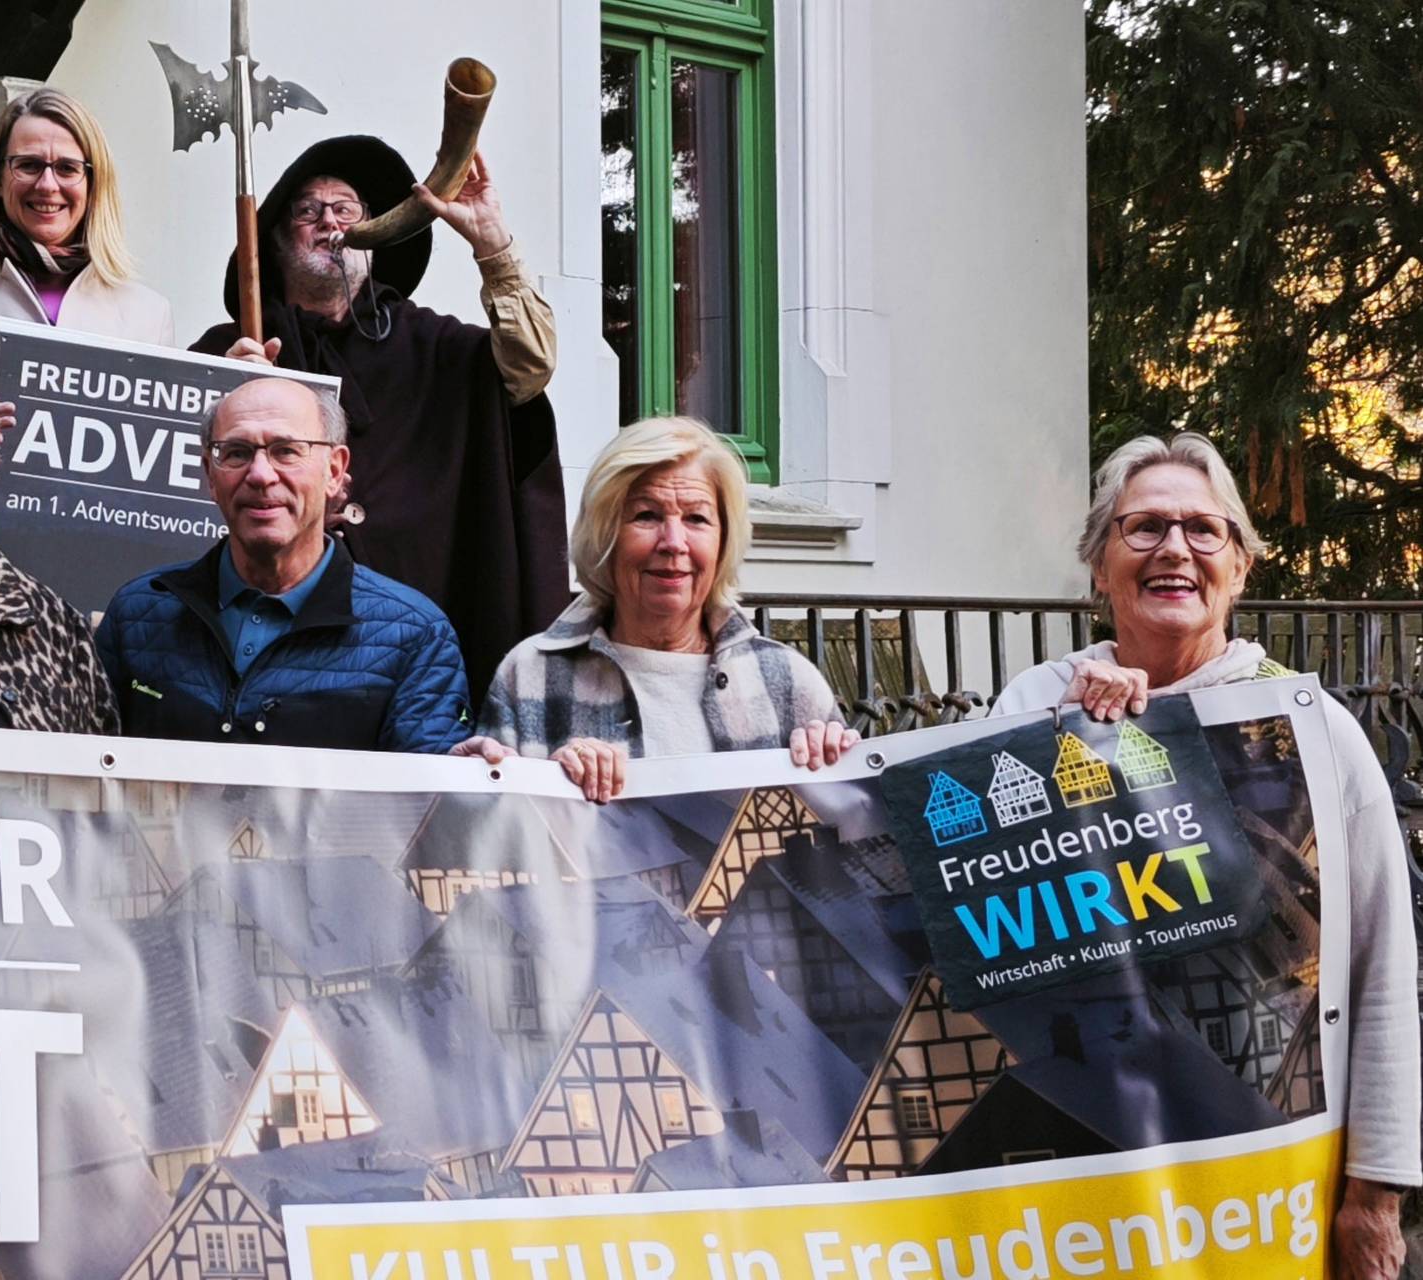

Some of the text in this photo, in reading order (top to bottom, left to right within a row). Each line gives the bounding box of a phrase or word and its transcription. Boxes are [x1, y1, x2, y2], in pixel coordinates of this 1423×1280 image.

[20, 360, 230, 416] FREUDENBE
[12, 409, 202, 490] ADVE
[6, 492, 230, 539] am 1. Adventswoche
[938, 803, 1202, 893] Freudenberg
[954, 842, 1213, 960] WIRKT
[977, 912, 1238, 990] Wirtschaft Kultur Tourismus
[702, 1233, 782, 1280] in
[805, 1180, 1318, 1280] Freudenberg
